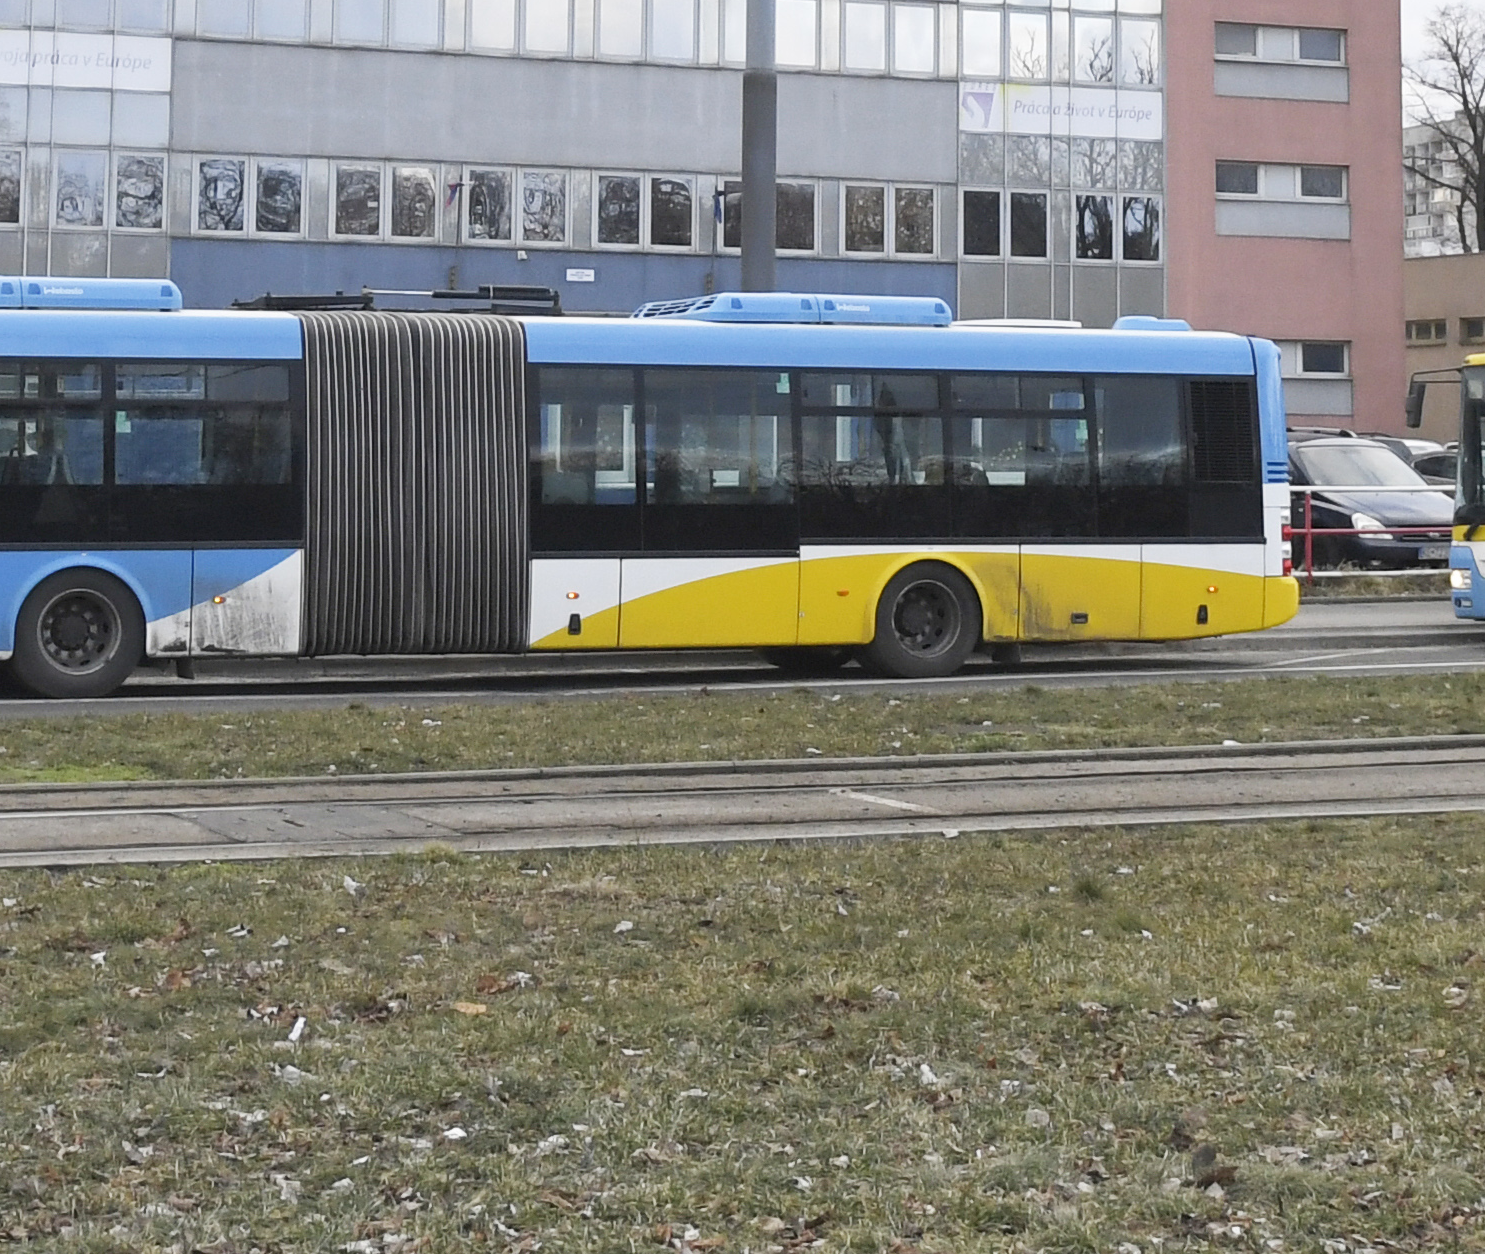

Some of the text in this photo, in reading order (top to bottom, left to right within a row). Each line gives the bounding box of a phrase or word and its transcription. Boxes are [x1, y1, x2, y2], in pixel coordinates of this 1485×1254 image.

[30, 50, 78, 68] práca
[82, 56, 92, 66] v
[95, 52, 152, 71] Európe
[1013, 100, 1153, 123] Práca a život v Európe
